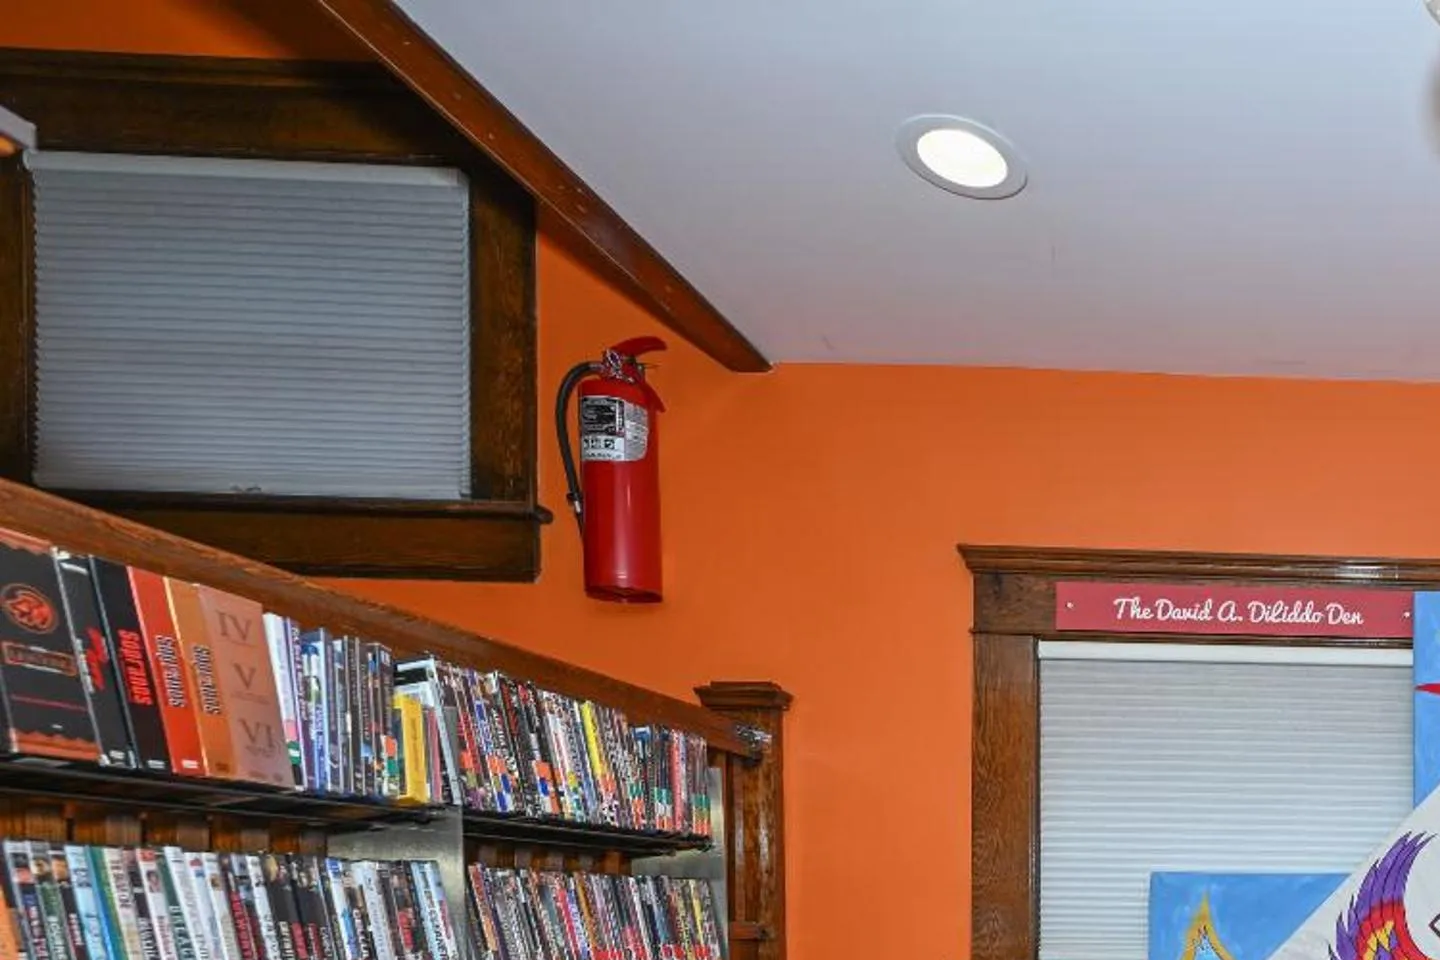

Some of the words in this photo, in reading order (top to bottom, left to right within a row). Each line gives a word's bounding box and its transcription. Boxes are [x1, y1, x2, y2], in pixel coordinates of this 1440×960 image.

[1113, 597, 1153, 621] The
[1156, 600, 1212, 623] David
[1216, 603, 1243, 623] A.
[1327, 604, 1365, 626] Den
[216, 611, 252, 642] IV
[233, 663, 257, 689] V
[239, 718, 275, 745] VI
